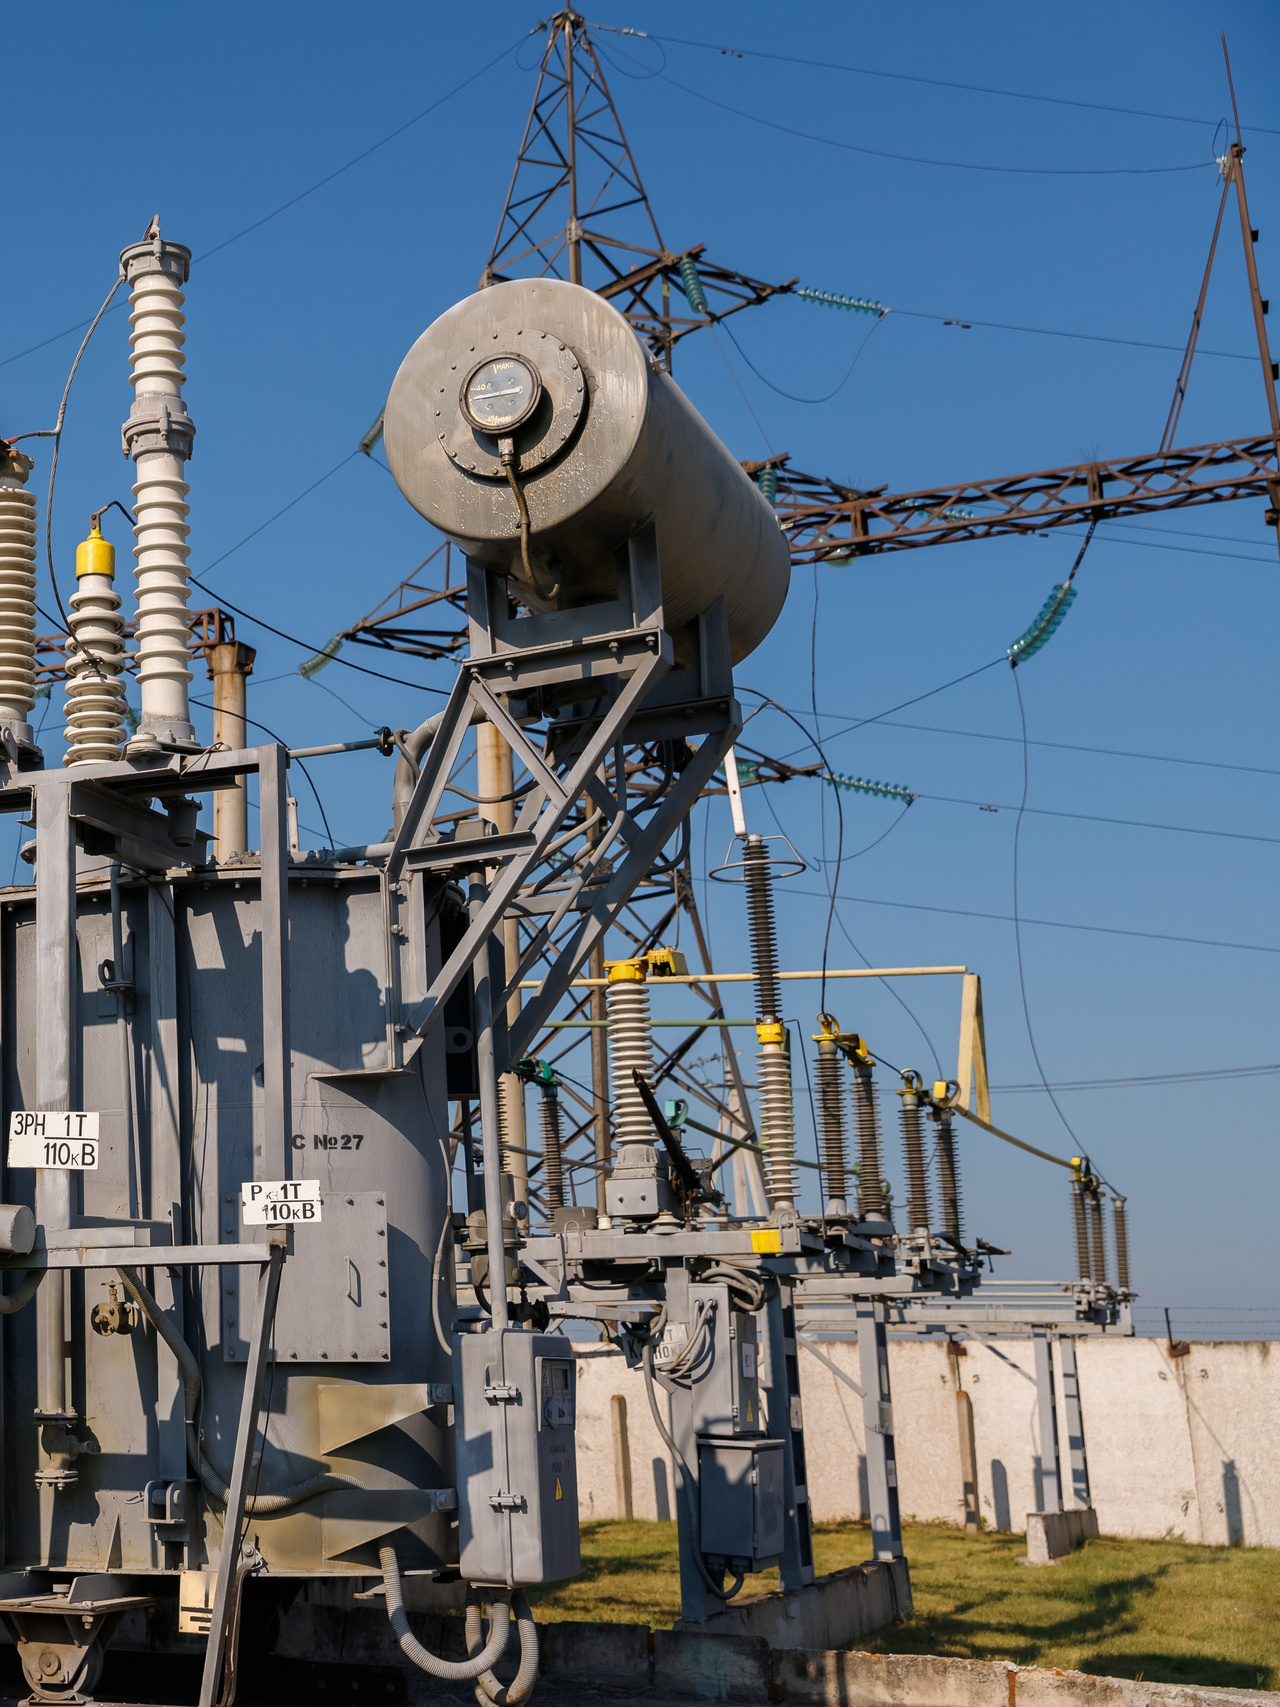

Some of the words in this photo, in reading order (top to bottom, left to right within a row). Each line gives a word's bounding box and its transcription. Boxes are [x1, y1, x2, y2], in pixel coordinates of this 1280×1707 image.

[496, 362, 514, 371] МАКС
[43, 1142, 96, 1166] 110кВ
[280, 1183, 302, 1200] 1Т
[262, 1202, 315, 1221] 110кВ
